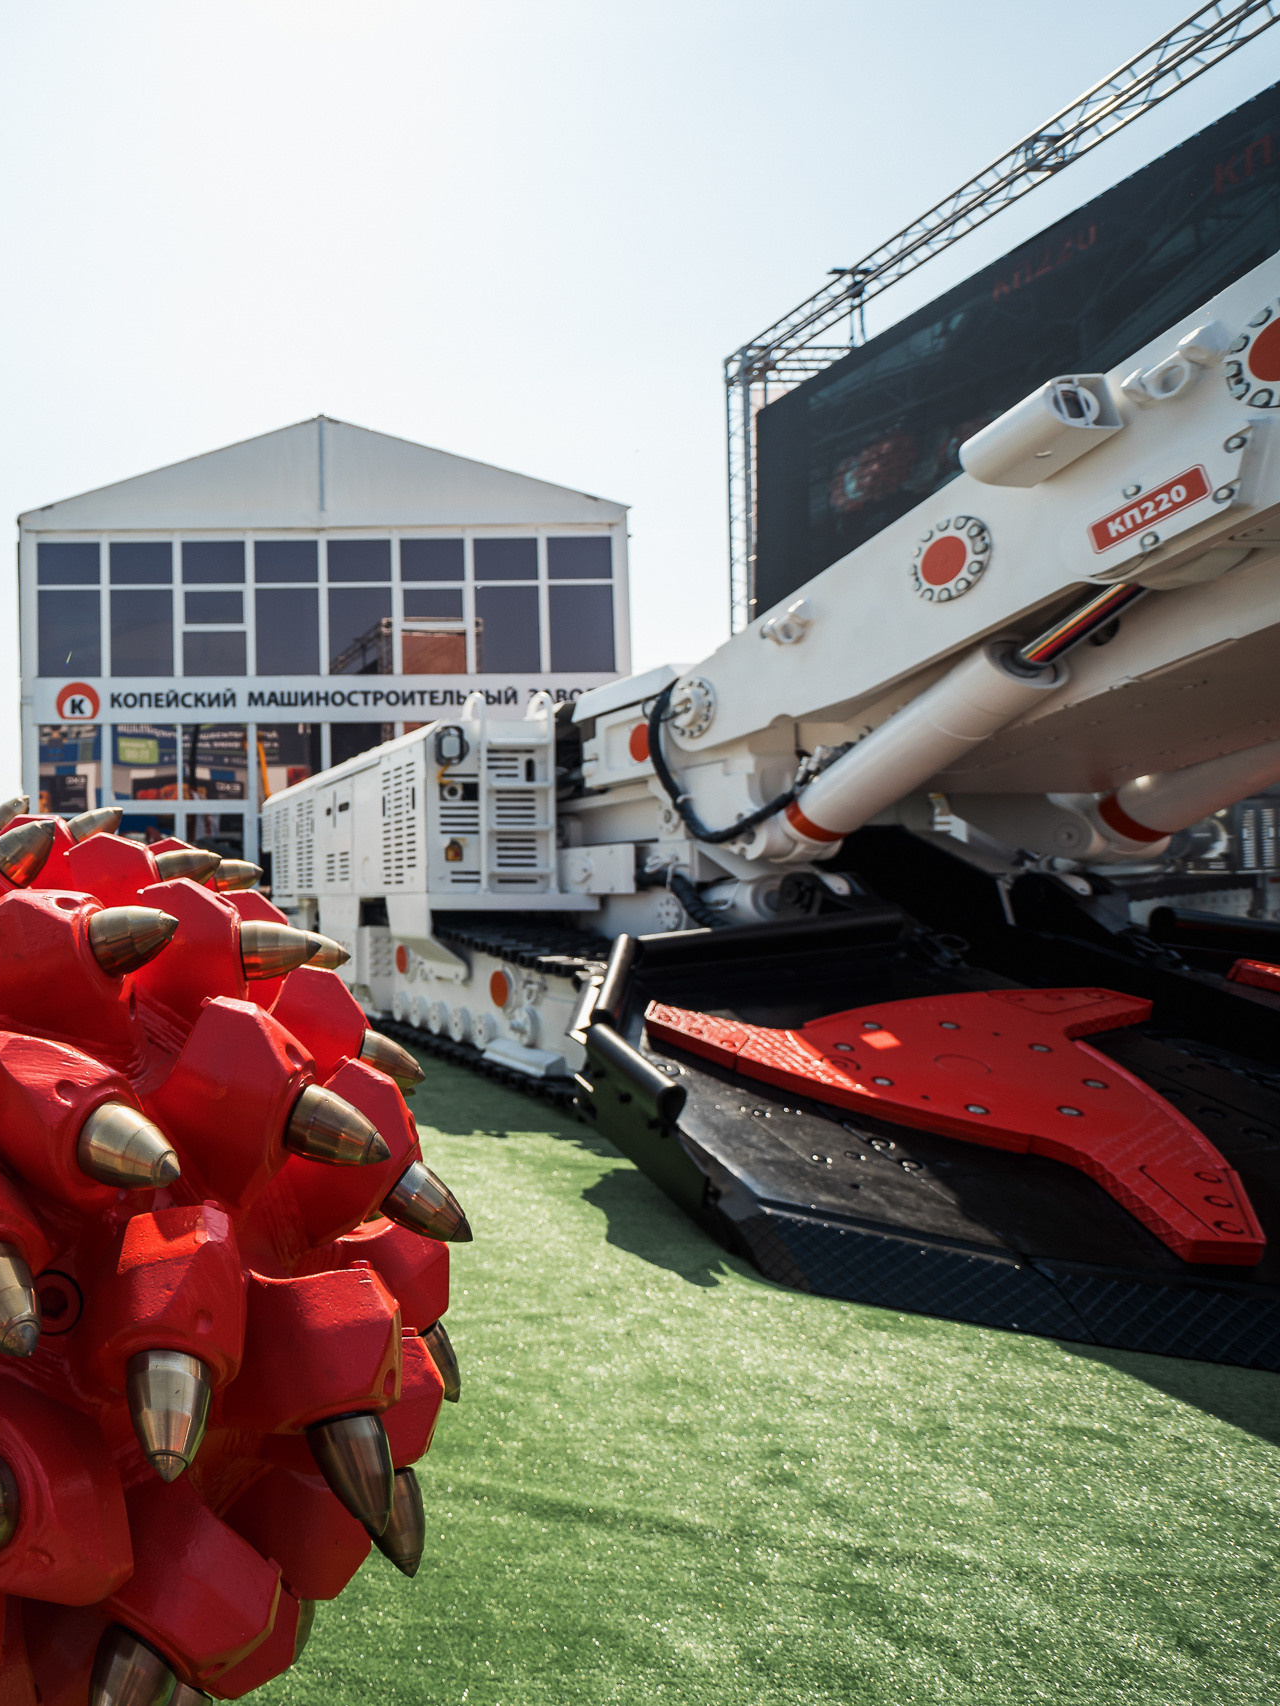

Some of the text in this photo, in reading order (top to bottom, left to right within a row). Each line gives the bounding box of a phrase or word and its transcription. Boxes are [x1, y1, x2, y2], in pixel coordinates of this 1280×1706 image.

[1213, 126, 1280, 195] КП
[1107, 485, 1187, 538] КП220
[70, 698, 86, 715] К
[110, 688, 236, 708] КОПЕЙСКИЙ
[248, 686, 518, 708] МАШИНОСТРОИТЕЛЬЫЙ
